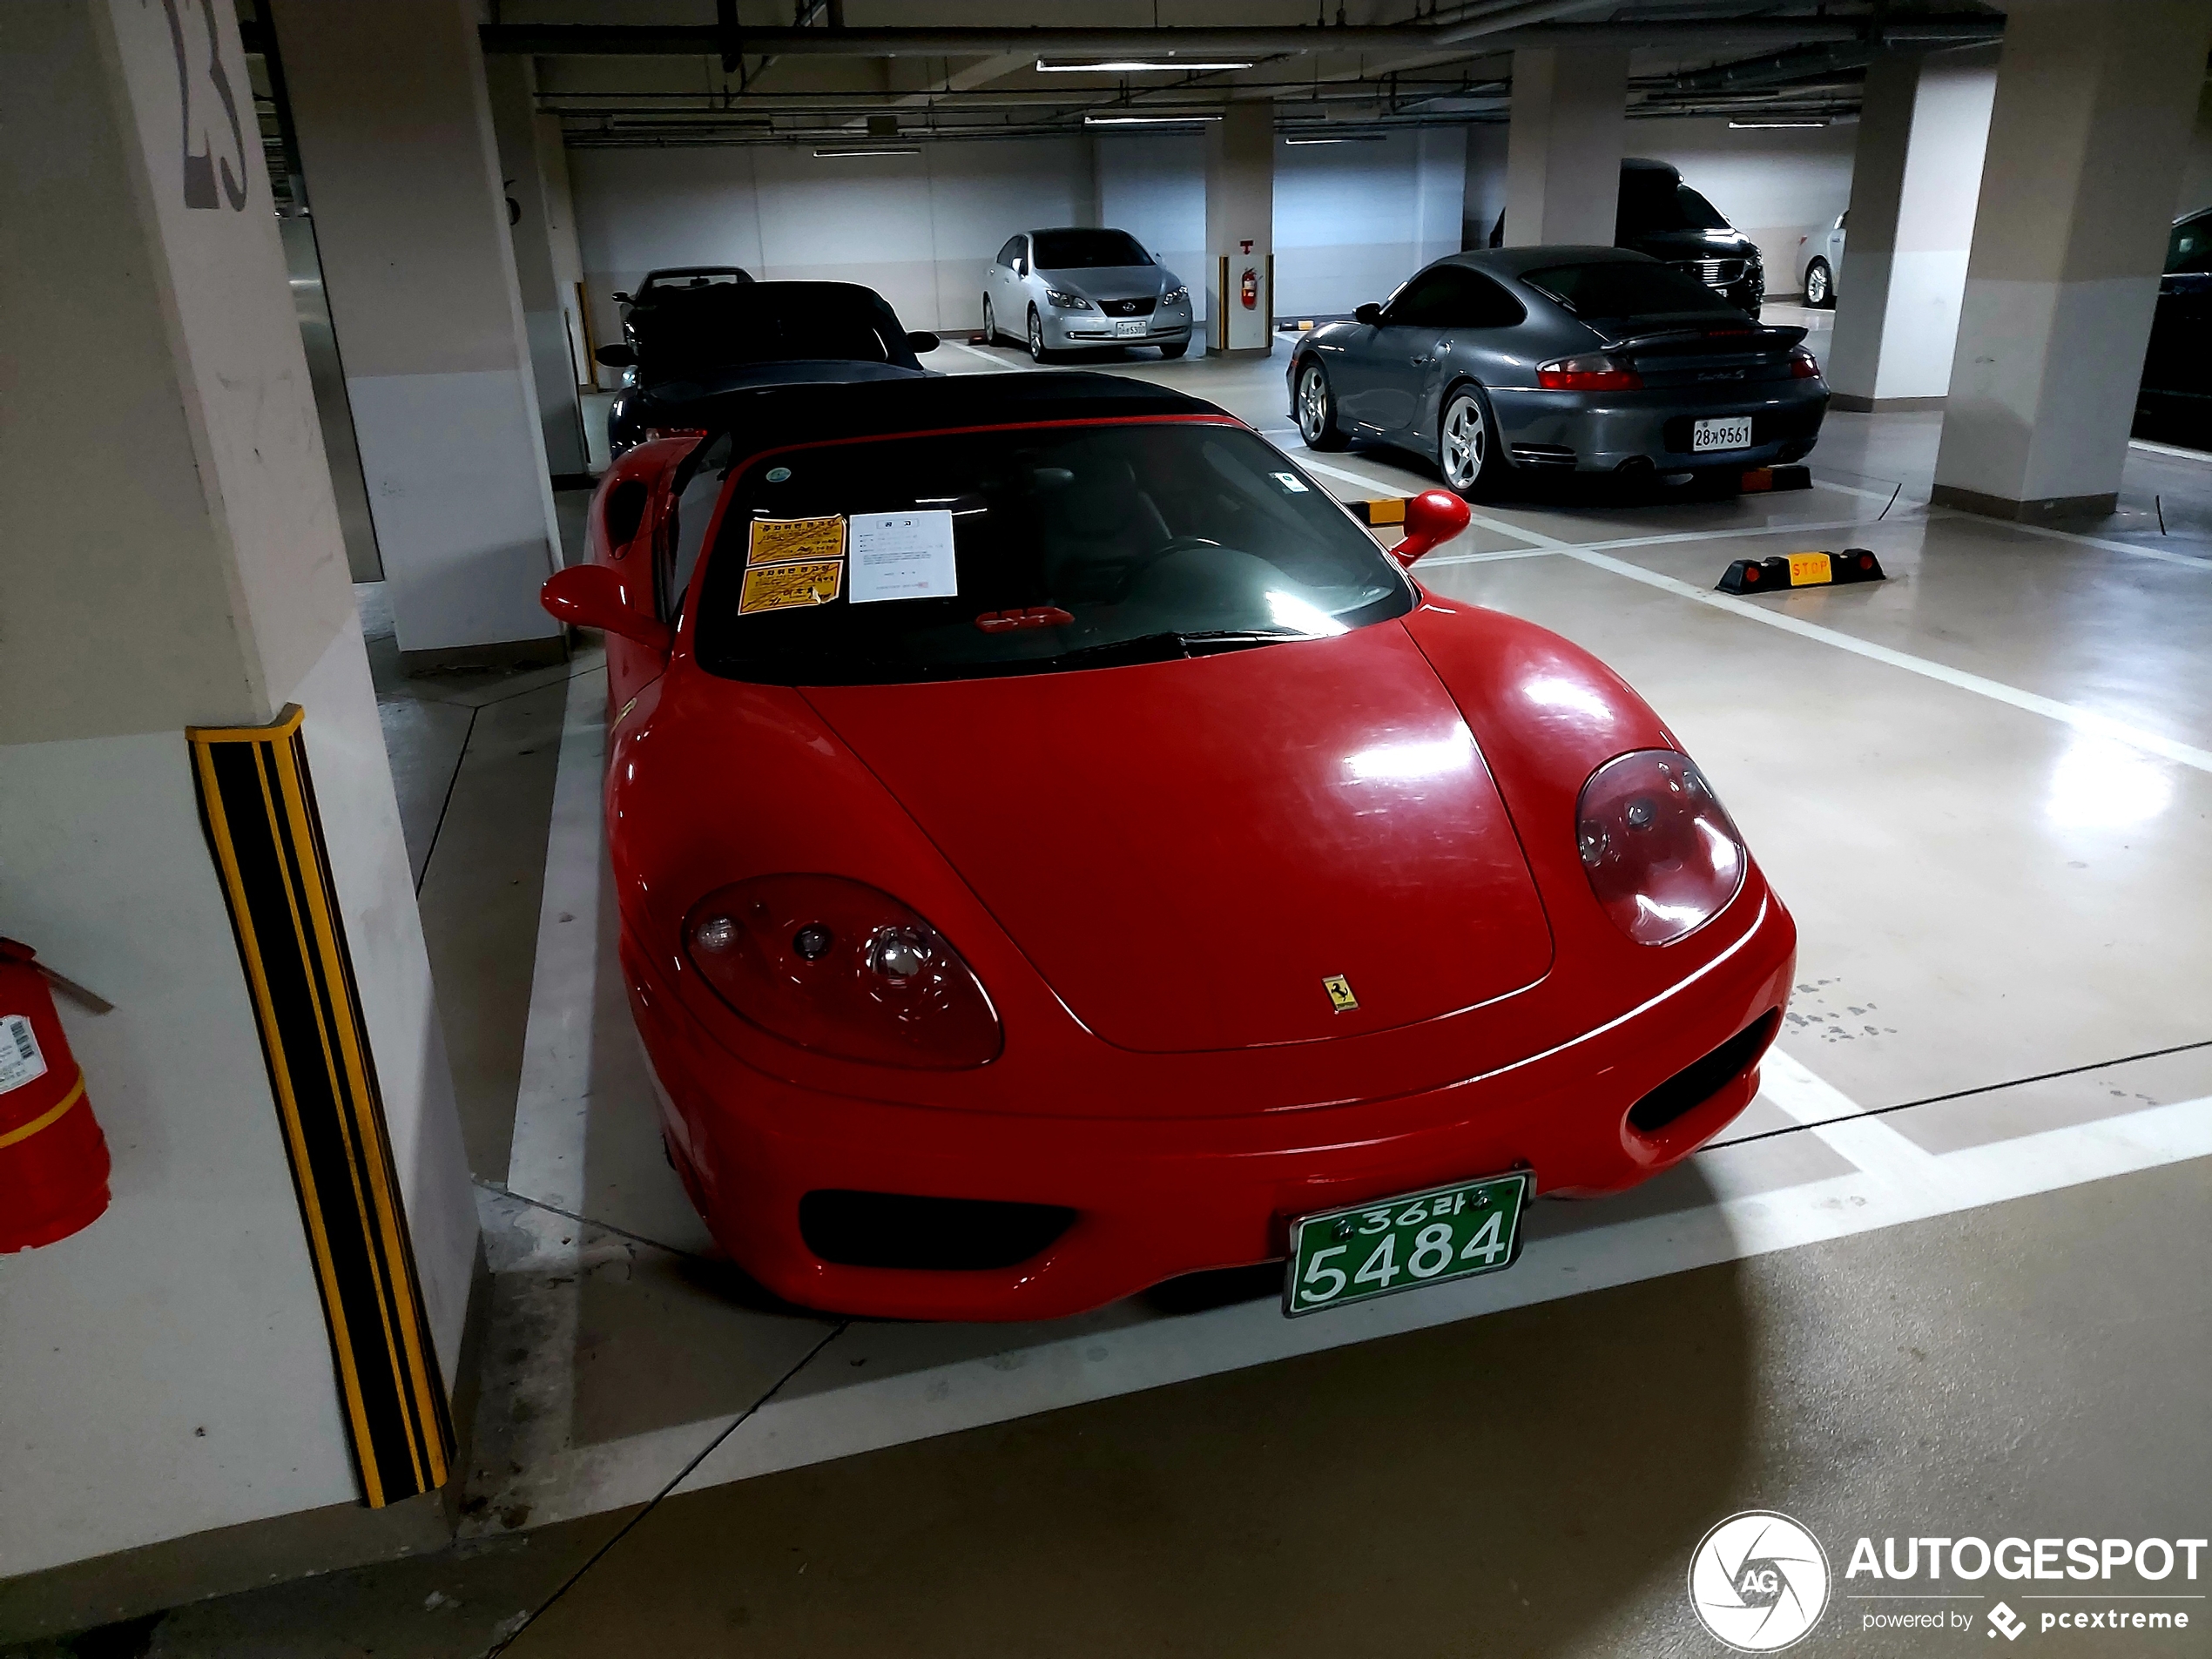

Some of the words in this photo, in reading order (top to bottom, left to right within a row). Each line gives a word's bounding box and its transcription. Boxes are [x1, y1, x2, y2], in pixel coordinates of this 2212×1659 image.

[1696, 427, 1749, 447] 28거9561
[1793, 560, 1827, 576] STOP
[1359, 1192, 1467, 1235] 36라
[1300, 1211, 1505, 1303] 5484
